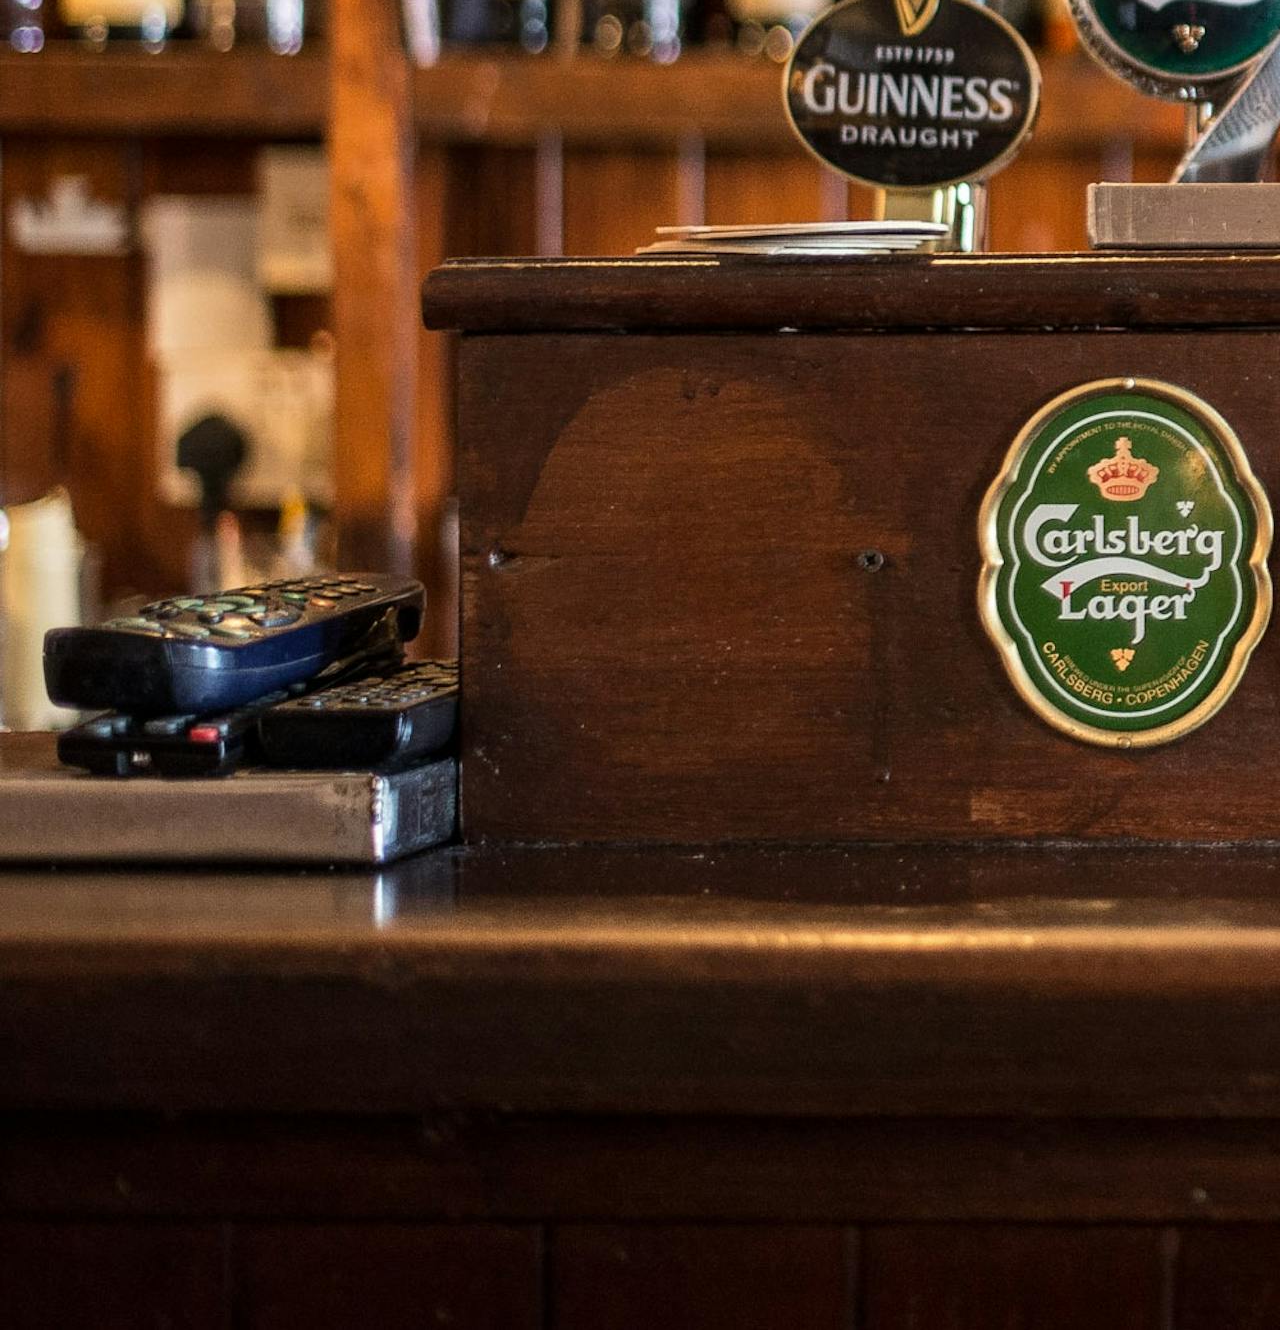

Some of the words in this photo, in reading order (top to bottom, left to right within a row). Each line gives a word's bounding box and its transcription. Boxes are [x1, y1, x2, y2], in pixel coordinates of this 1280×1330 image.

[916, 46, 956, 64] 1759
[803, 64, 1014, 122] GUINNESS
[839, 123, 979, 149] DRAUGHT
[1023, 503, 1225, 571] Carlsberg
[1058, 581, 1199, 645] Lager
[1100, 578, 1149, 595] Export
[1042, 641, 1113, 705] CARLSBERG
[1125, 639, 1210, 706] COPENHAGEN
